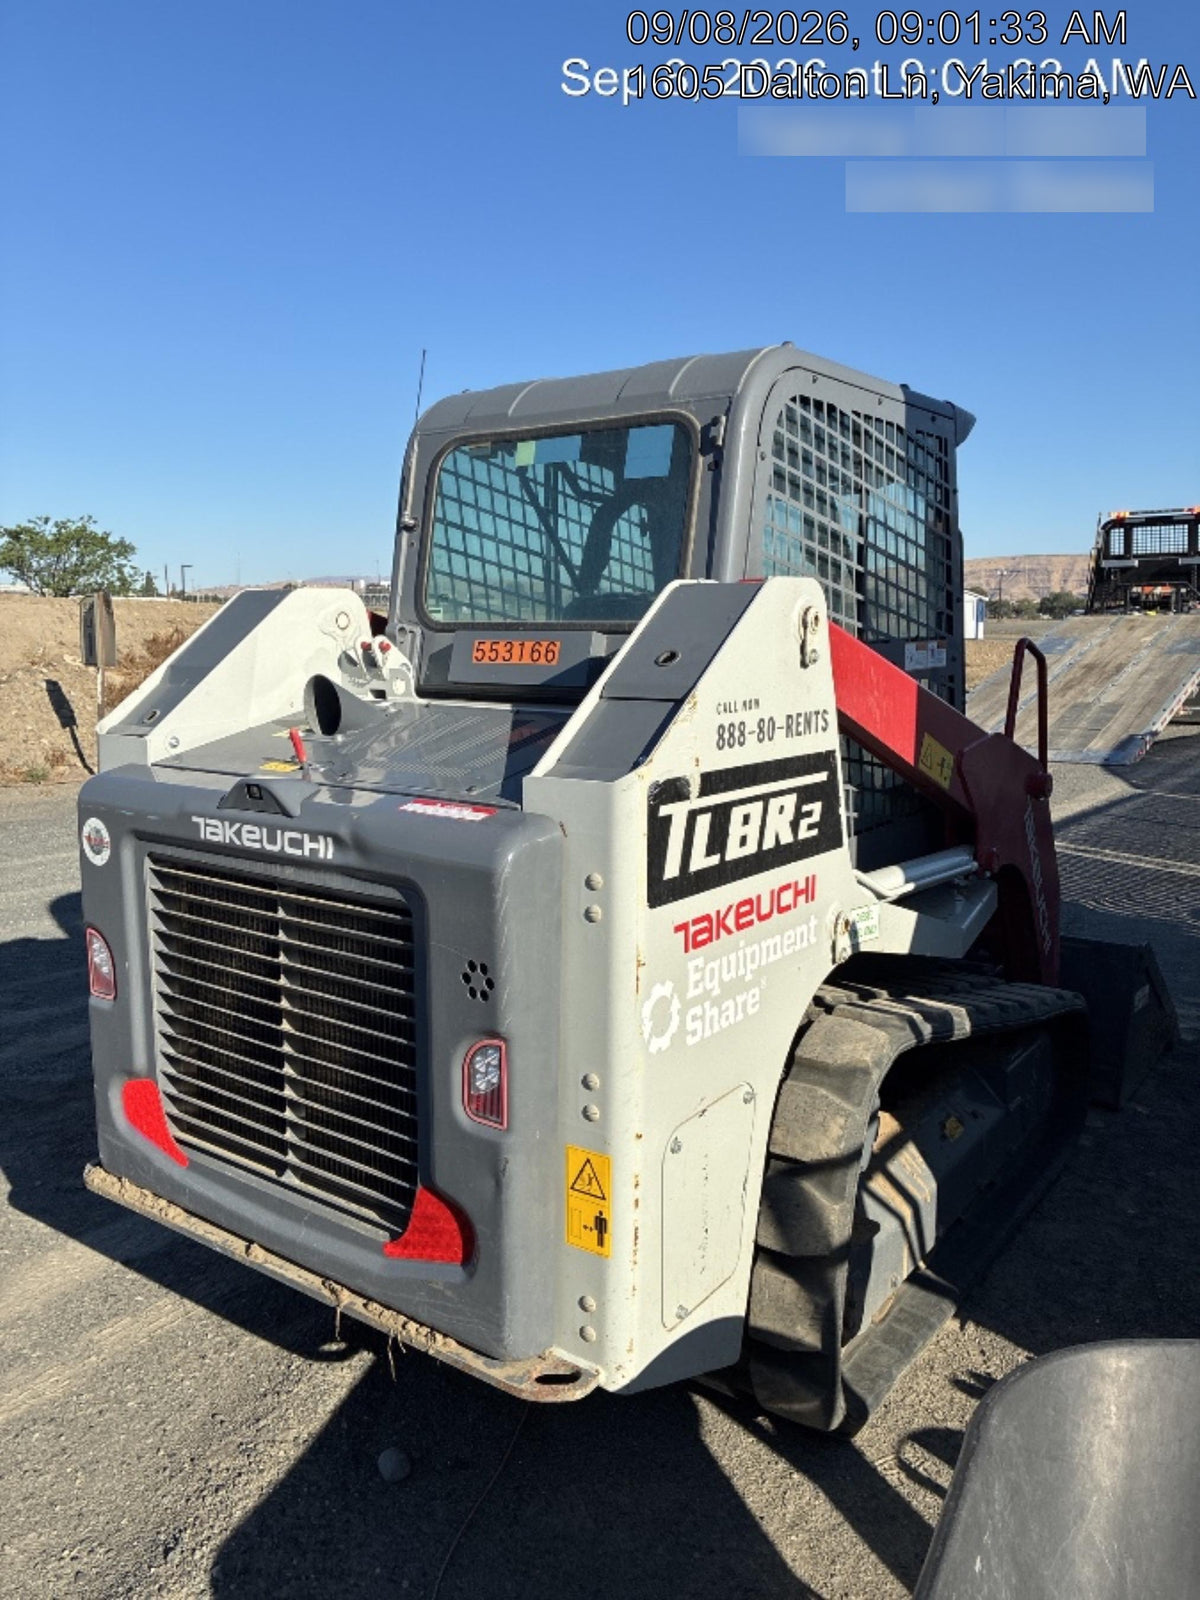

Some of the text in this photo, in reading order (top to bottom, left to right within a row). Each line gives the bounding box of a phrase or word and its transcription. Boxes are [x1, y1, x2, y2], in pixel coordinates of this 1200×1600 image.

[474, 641, 557, 663] 553166
[716, 708, 829, 751] 888-80-RENTS
[192, 815, 334, 859] TAKEUCHI
[673, 874, 816, 953] TAKEUCHI
[687, 914, 818, 1000] Equipment
[686, 990, 761, 1046] Share
